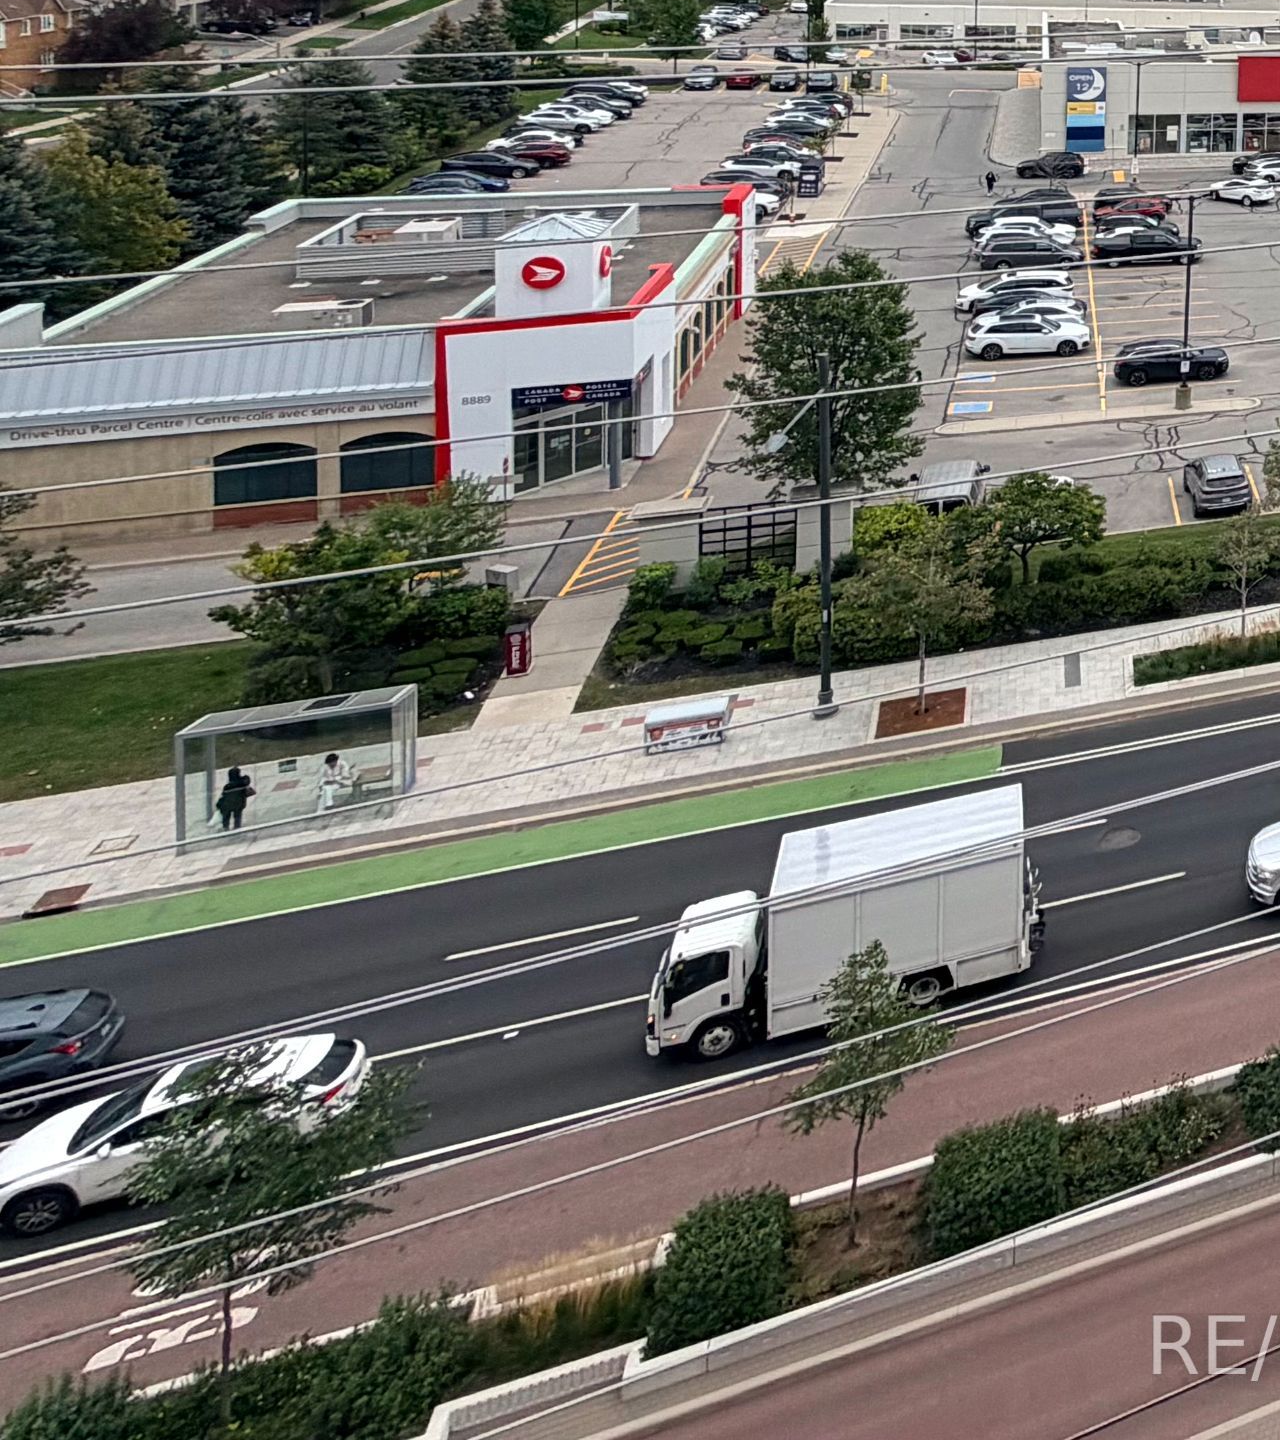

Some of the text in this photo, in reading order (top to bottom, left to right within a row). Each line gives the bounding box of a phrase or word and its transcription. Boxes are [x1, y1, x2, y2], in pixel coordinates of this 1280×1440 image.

[1076, 83, 1090, 91] 12
[585, 391, 621, 399] CANADA
[461, 395, 491, 406] 8889
[9, 399, 419, 441] Drive-thru Parcel Centre Centre-colis avec service au volant
